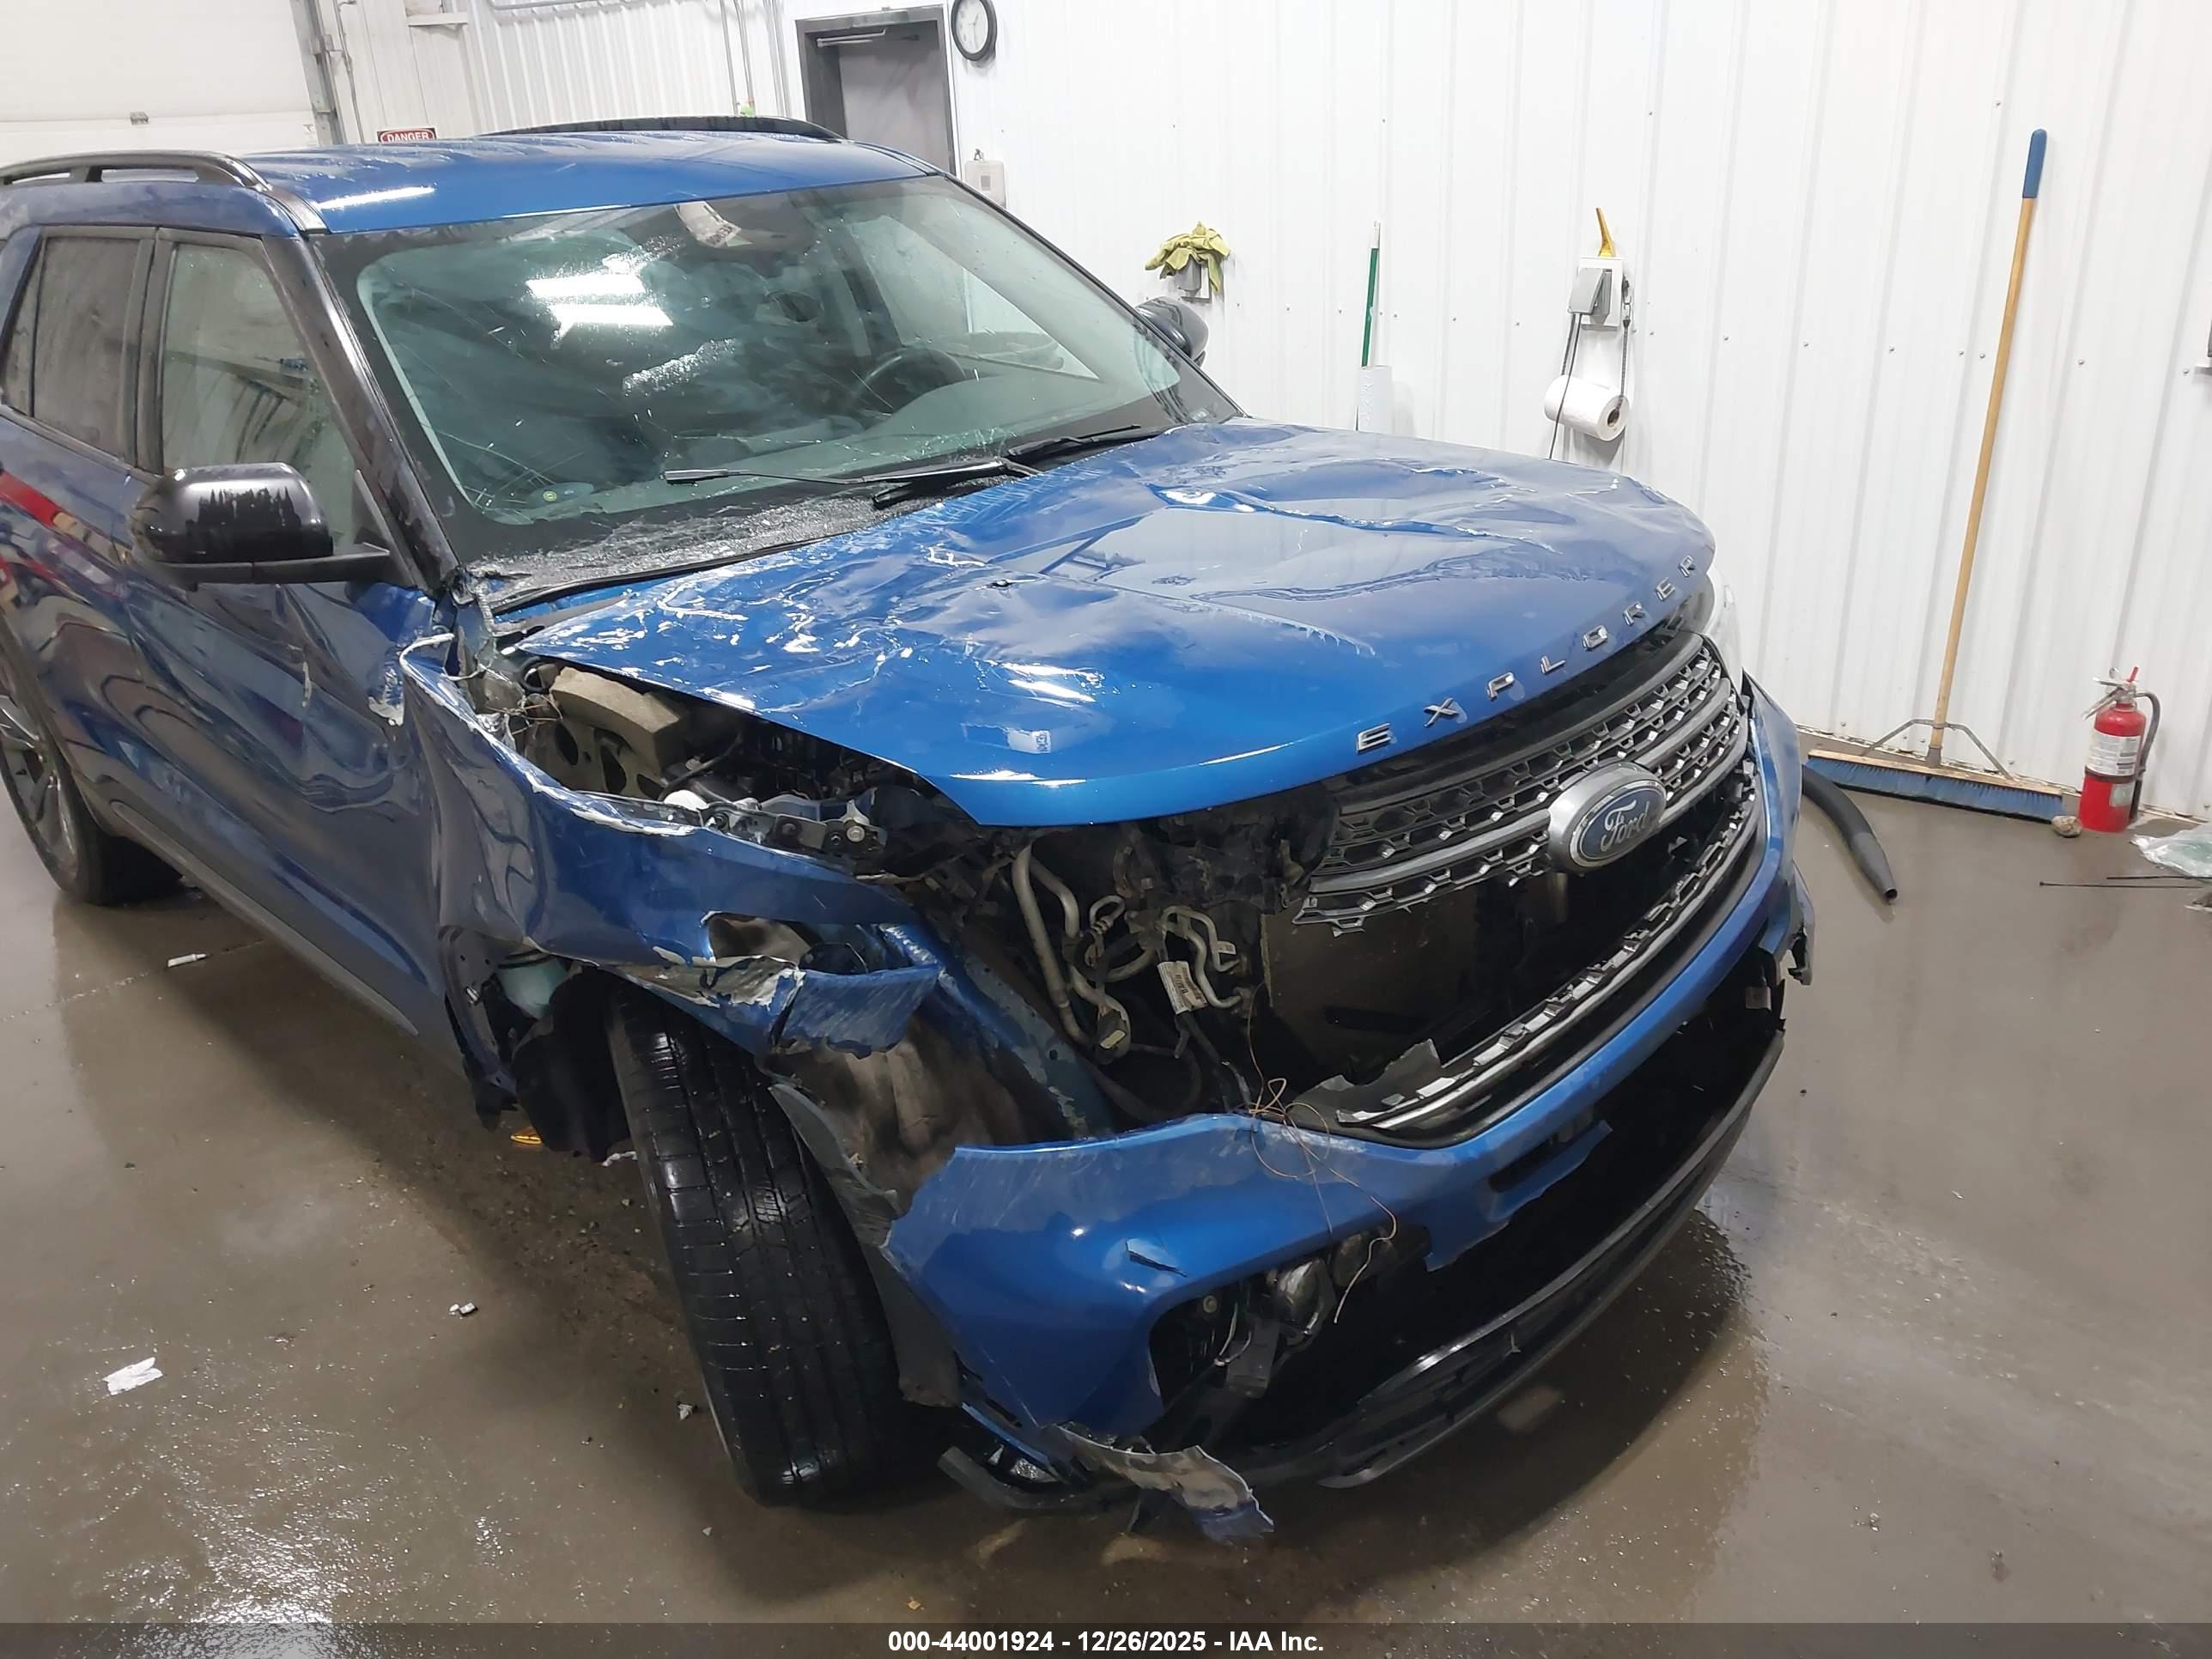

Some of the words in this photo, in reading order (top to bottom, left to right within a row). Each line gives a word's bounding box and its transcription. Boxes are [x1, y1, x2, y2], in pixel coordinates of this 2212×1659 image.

[386, 131, 429, 142] DANGER
[1356, 555, 1697, 754] EXPLORER
[1600, 799, 1650, 852] Ford
